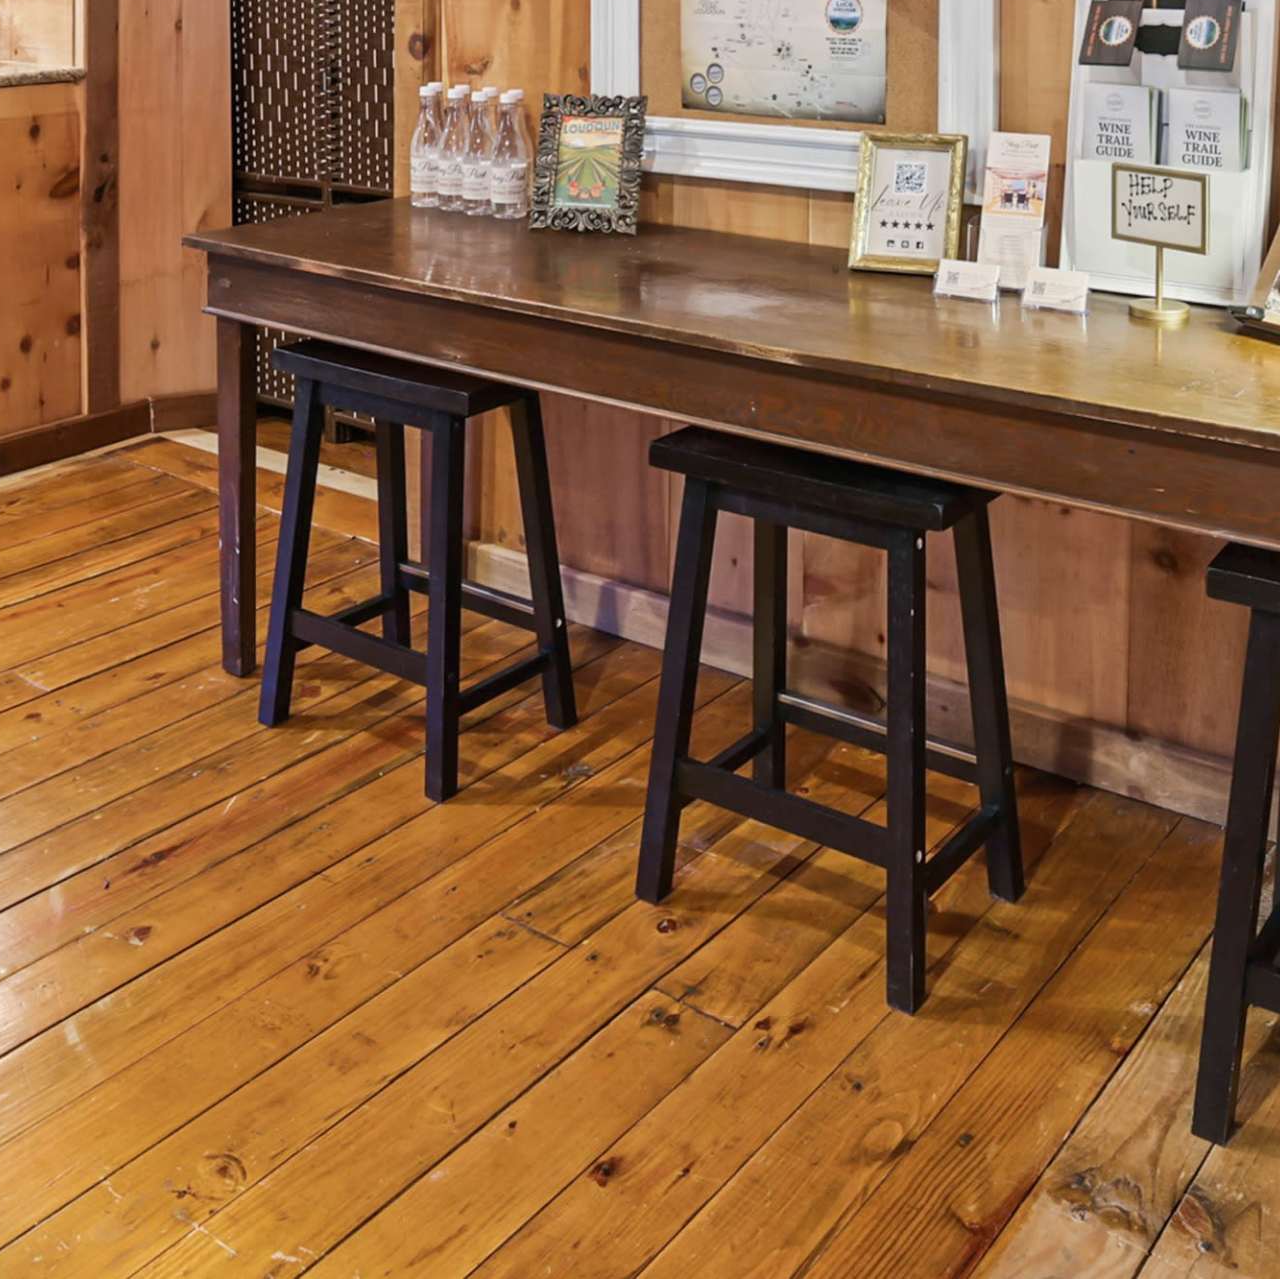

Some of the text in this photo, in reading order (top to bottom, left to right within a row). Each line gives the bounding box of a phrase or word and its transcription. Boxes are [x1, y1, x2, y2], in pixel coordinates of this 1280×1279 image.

[563, 119, 621, 134] LOUDOUN
[1098, 122, 1132, 135] WINE
[1097, 134, 1133, 147] TRAIL
[1185, 129, 1220, 143] WINE
[1095, 145, 1135, 159] GUIDE
[1183, 142, 1222, 156] TRAIL
[1181, 154, 1223, 168] GUIDE
[1128, 173, 1173, 198] HELP
